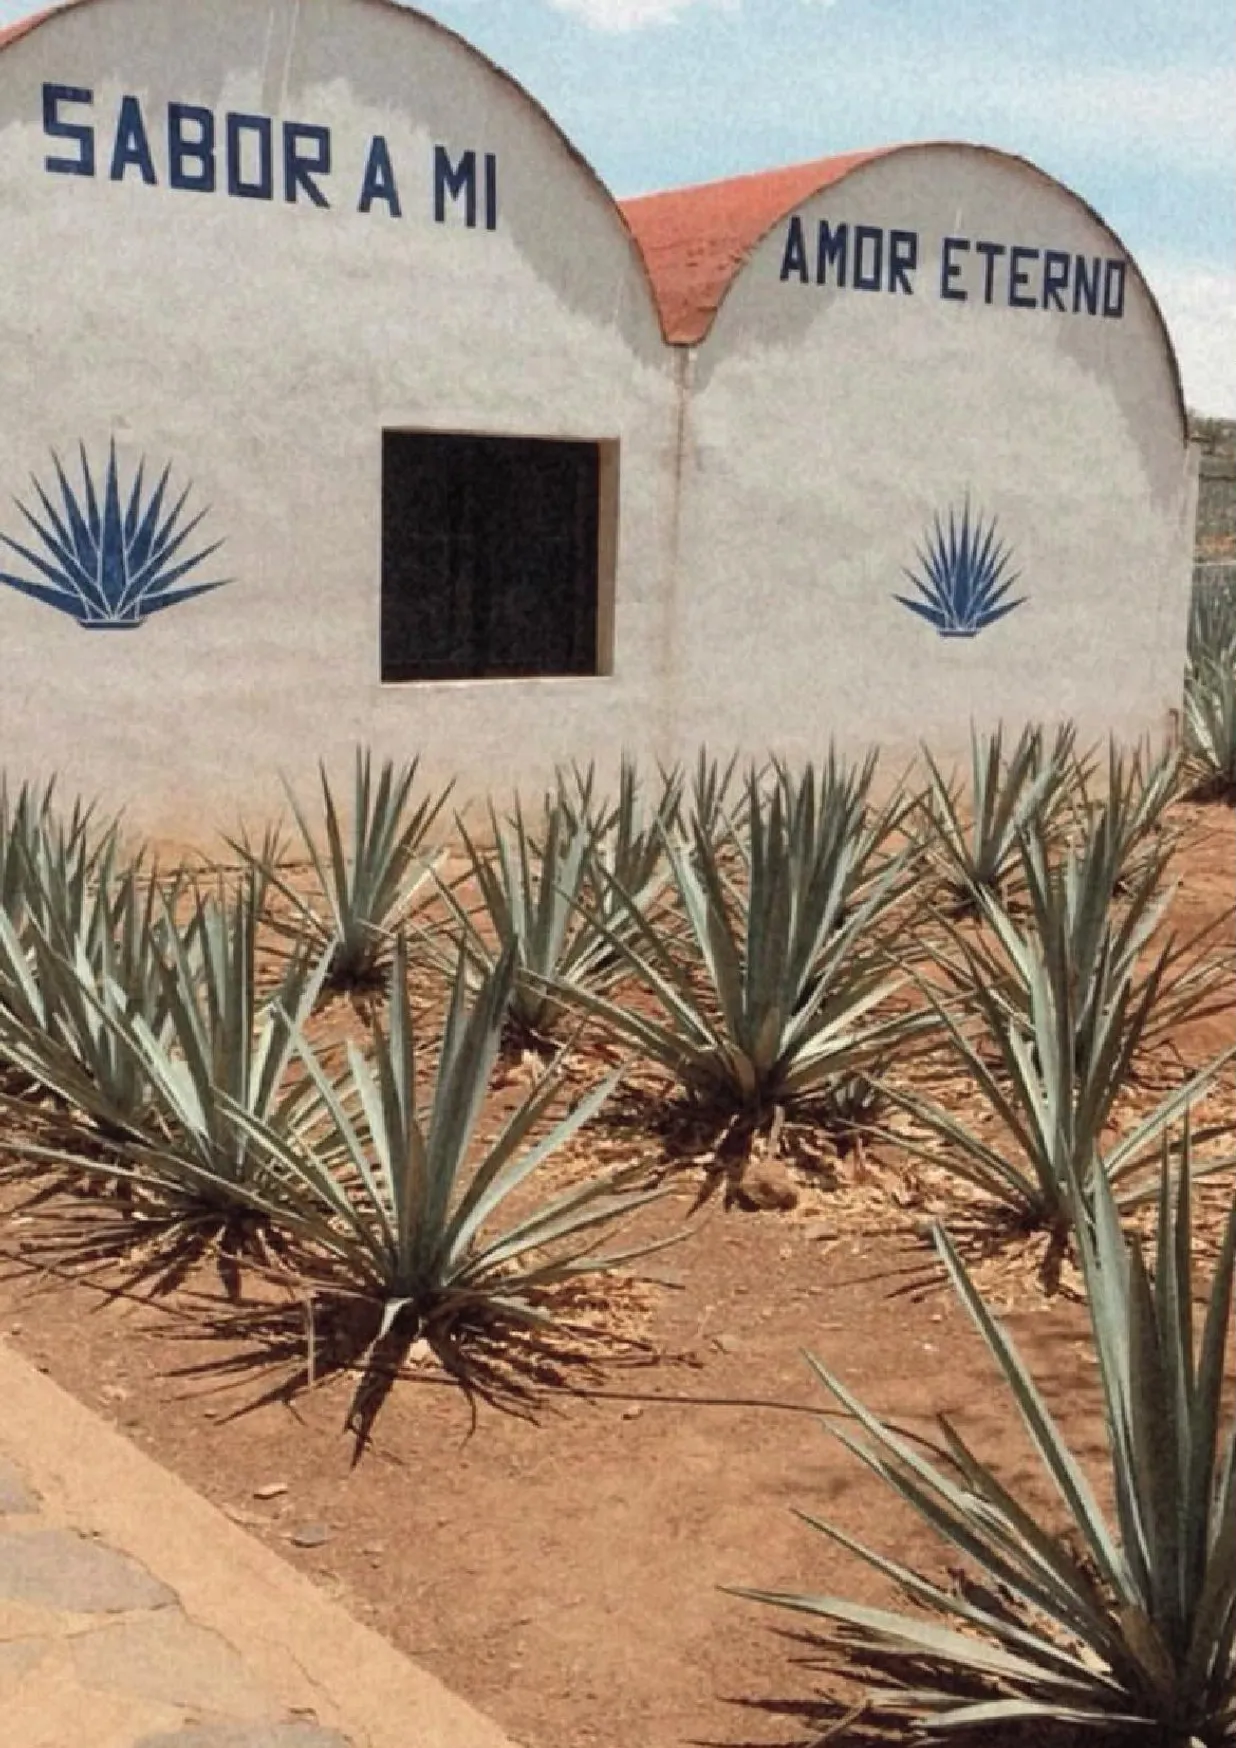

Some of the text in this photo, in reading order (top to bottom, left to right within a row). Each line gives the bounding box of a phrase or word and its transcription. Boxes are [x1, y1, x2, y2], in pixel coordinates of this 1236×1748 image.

[41, 81, 497, 231] SABOR A MI
[779, 214, 1126, 319] AMOR ETERNO
